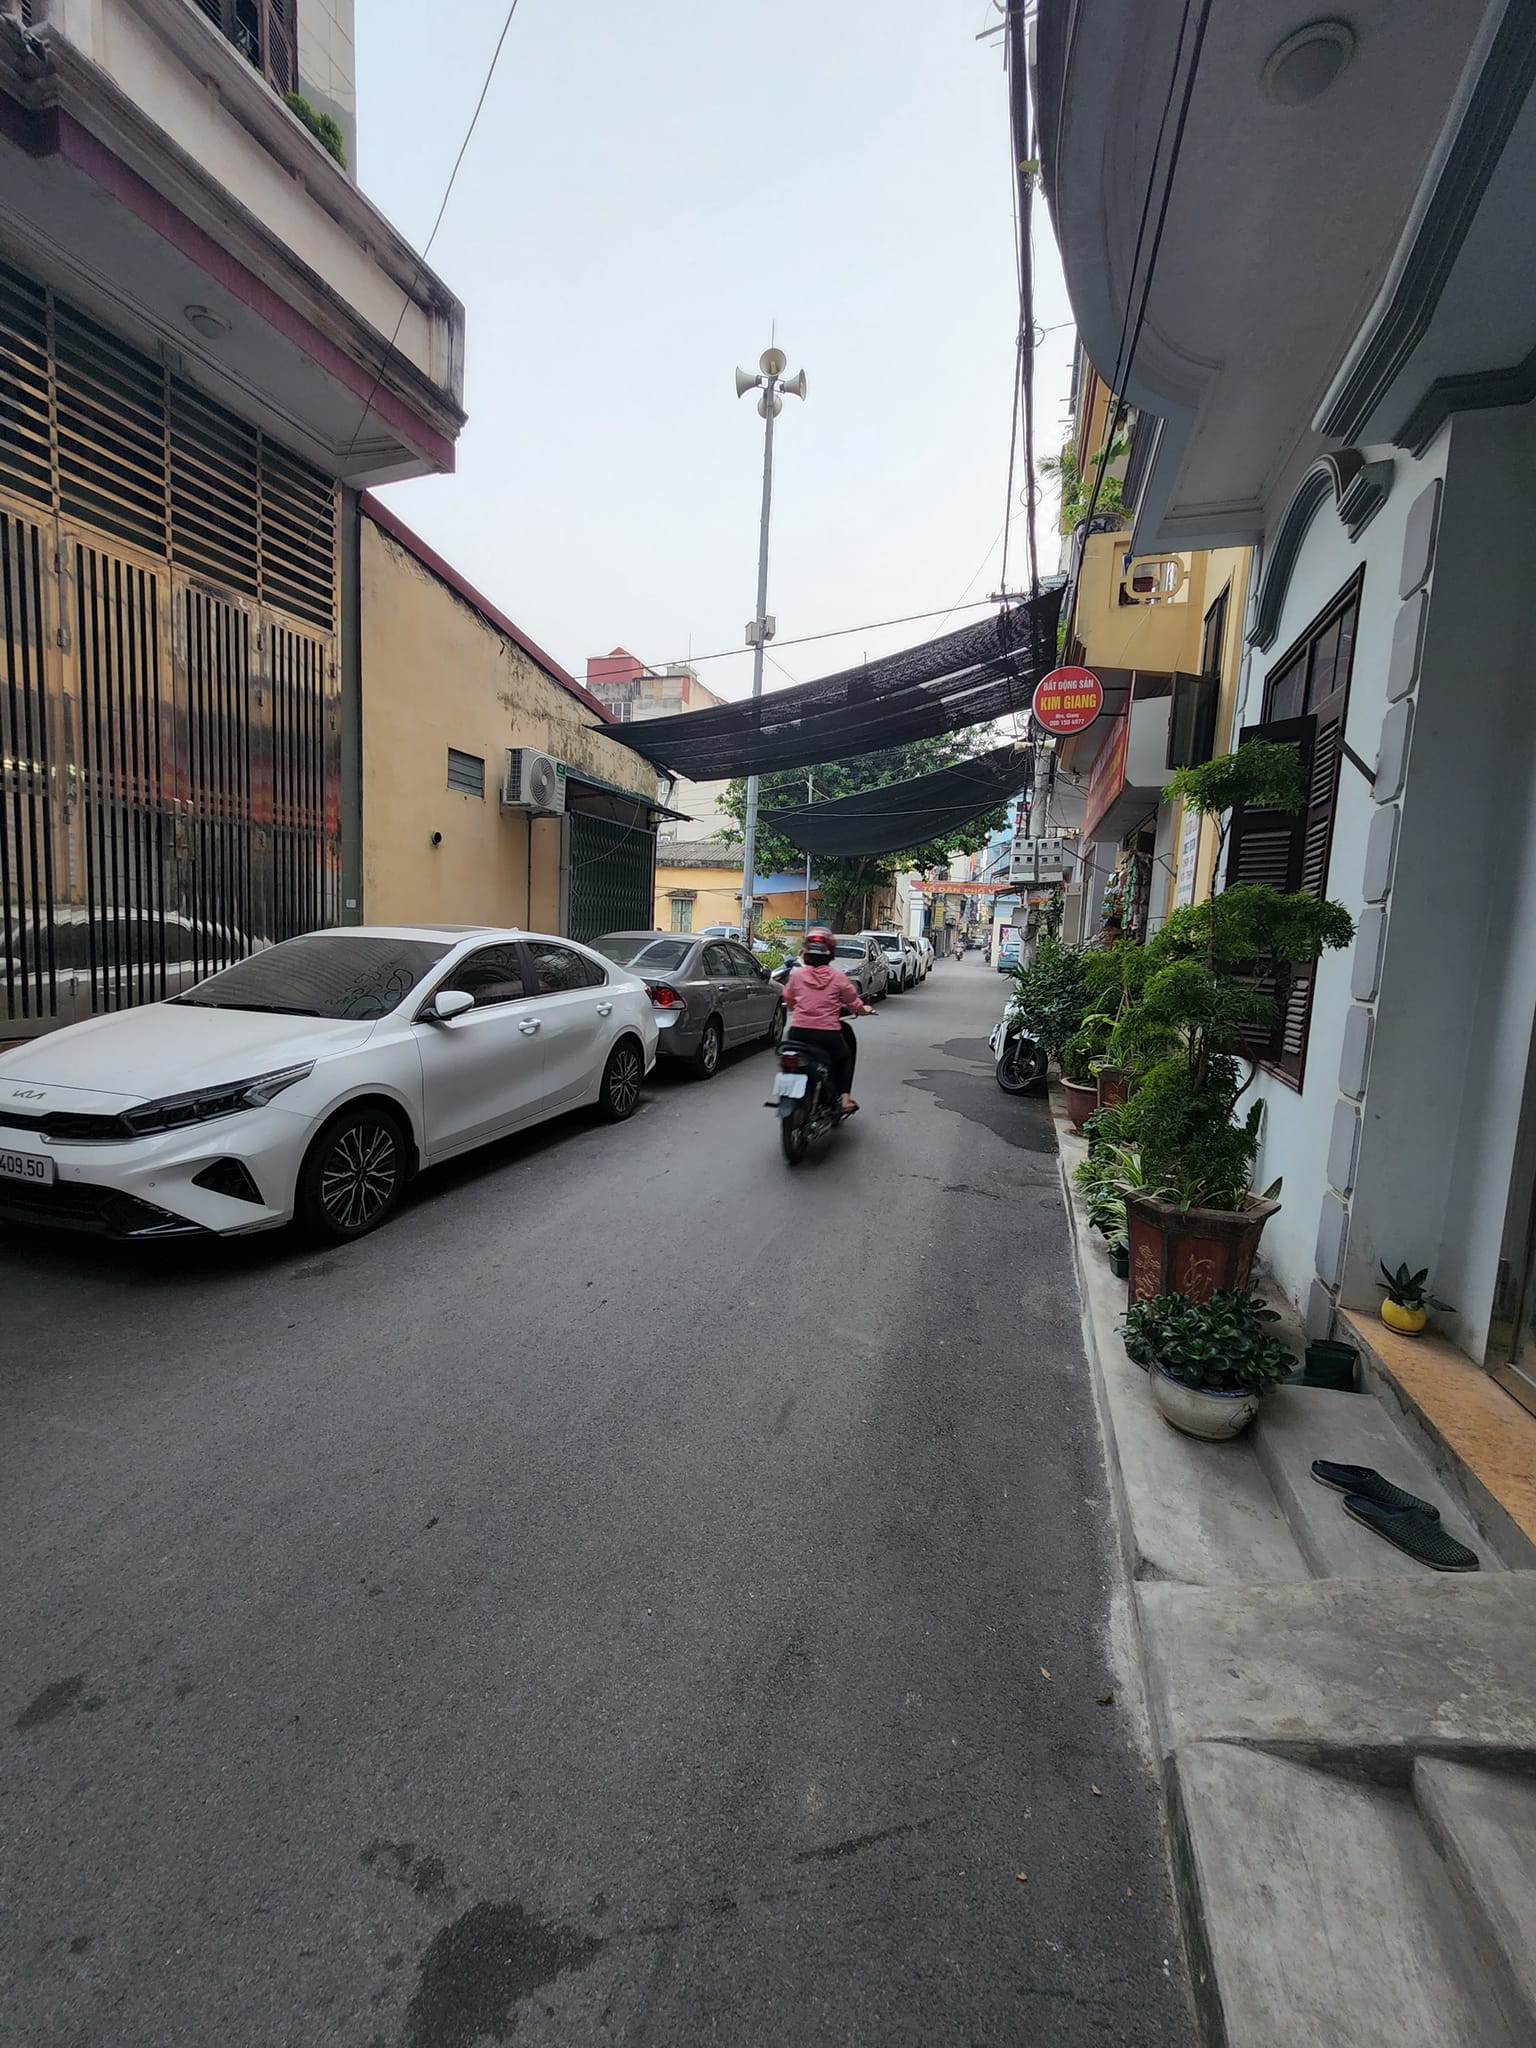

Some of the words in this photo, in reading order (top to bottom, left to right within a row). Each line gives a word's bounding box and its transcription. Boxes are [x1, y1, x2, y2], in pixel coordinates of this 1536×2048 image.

[1043, 679, 1056, 691] BẤT
[1058, 679, 1077, 692] ĐỘNG
[1079, 677, 1094, 688] SẢN
[1040, 696, 1061, 710] KIM
[1064, 694, 1096, 709] GIANG
[12, 1089, 47, 1100] KIA
